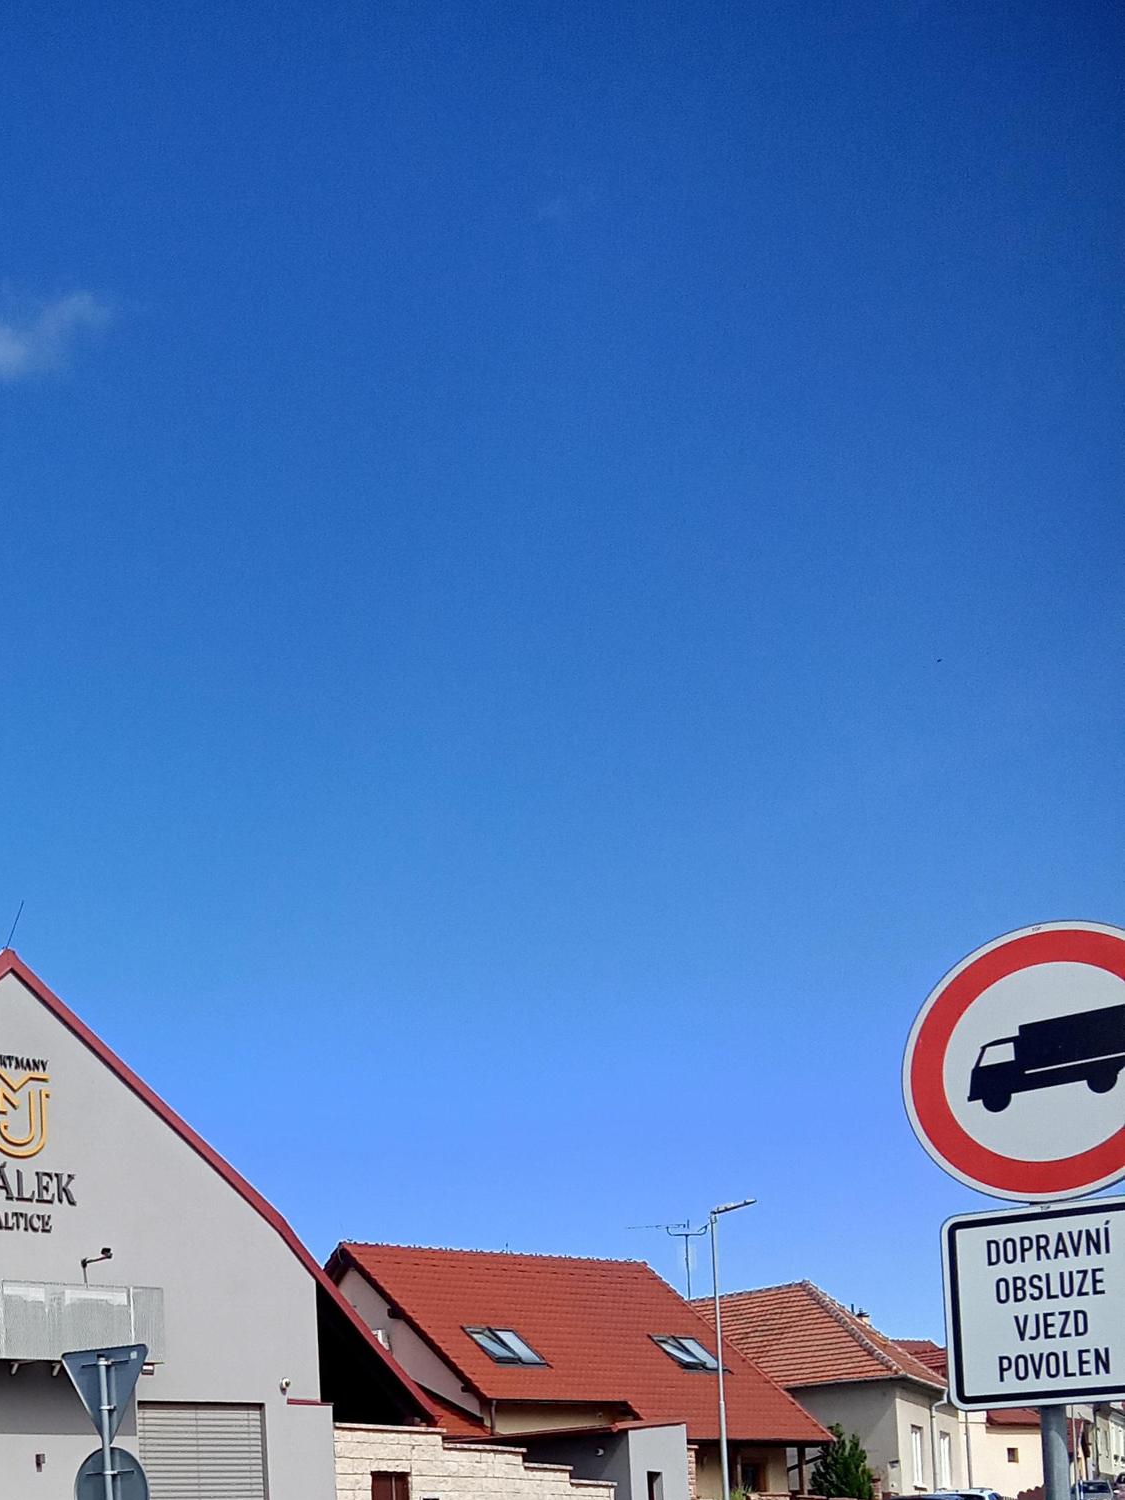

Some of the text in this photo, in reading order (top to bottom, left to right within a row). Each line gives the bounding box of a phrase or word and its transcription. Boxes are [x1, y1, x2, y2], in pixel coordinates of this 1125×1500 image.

[986, 1220, 1111, 1267] DOPRAVNÍ
[995, 1267, 1106, 1304] OBSLUZE
[1013, 1309, 1089, 1342] VJEZD
[998, 1347, 1111, 1383] POVOLEN
